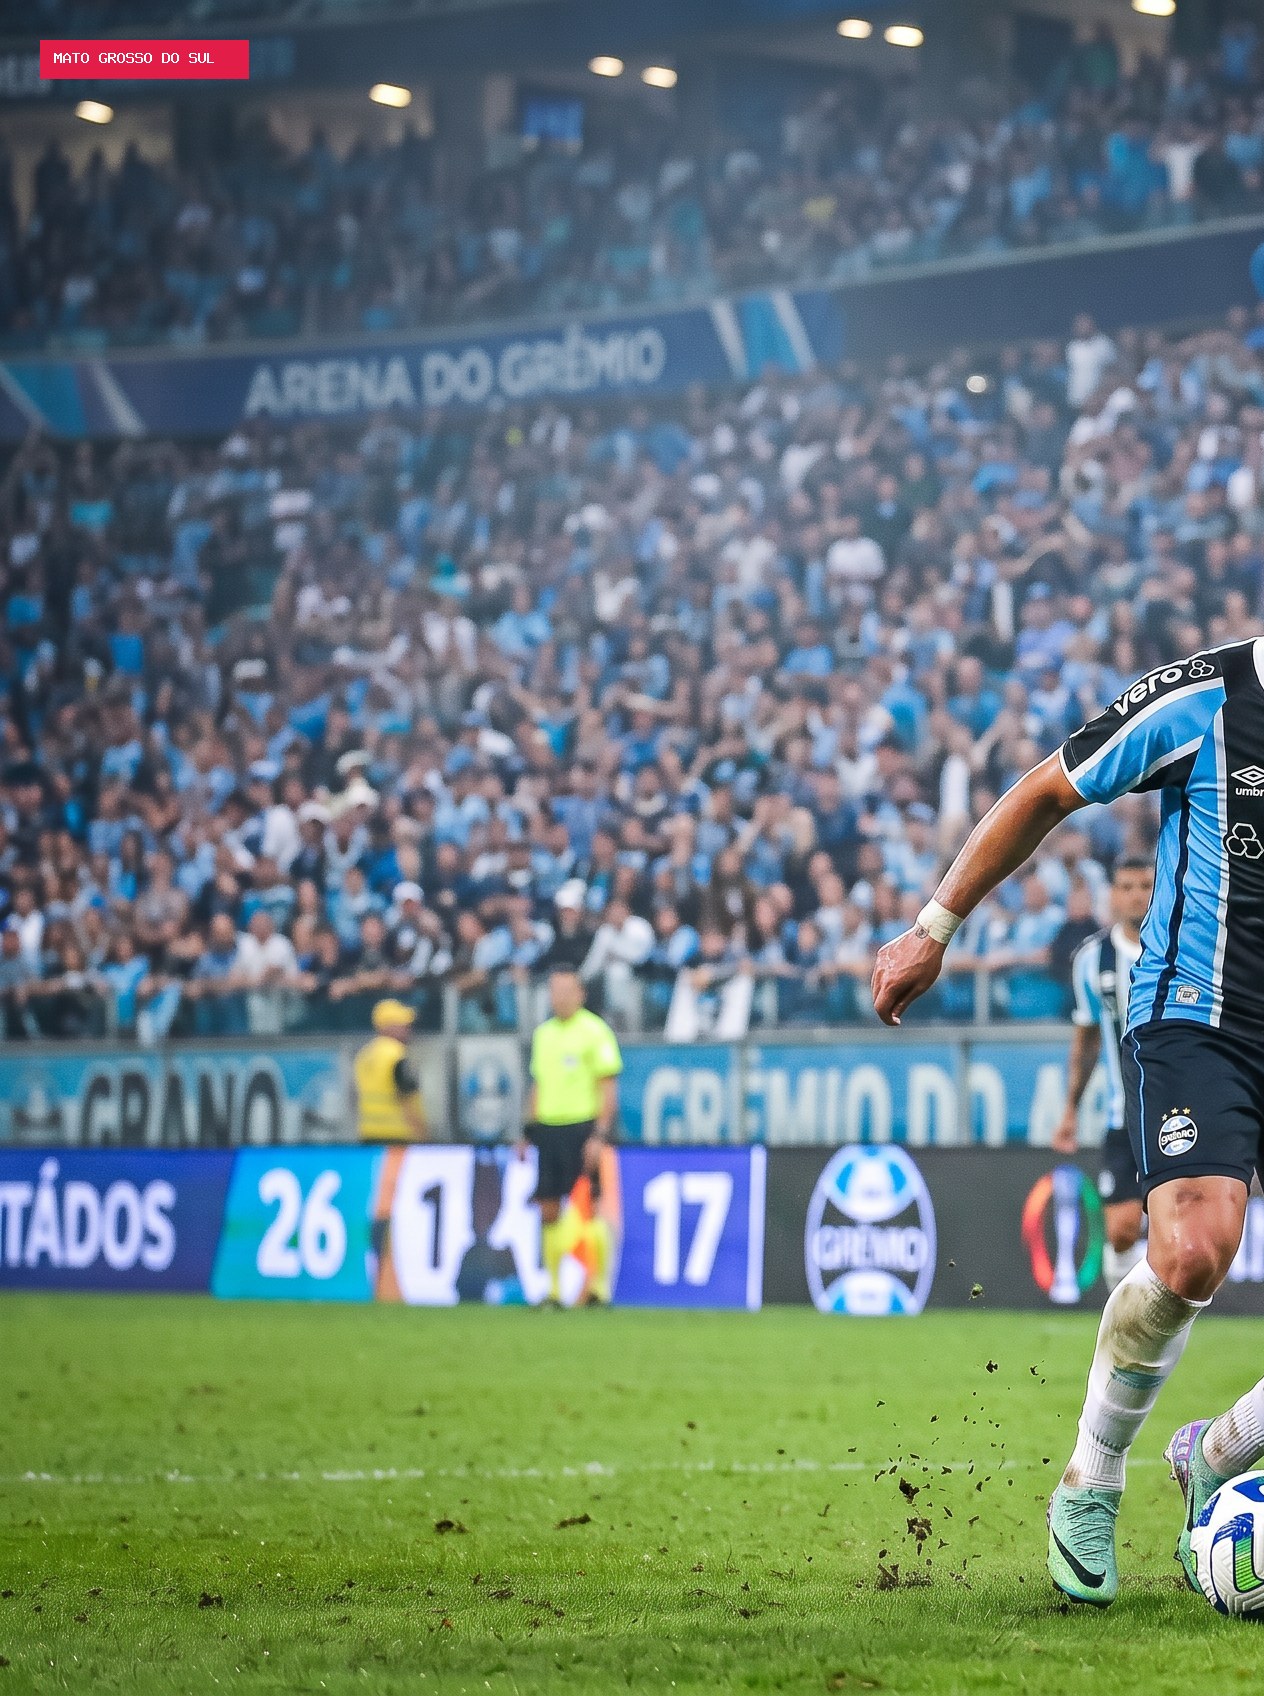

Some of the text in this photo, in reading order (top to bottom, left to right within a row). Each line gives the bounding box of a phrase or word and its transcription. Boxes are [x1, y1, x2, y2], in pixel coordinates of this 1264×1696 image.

[244, 355, 416, 419] ARENA
[420, 346, 493, 404] DO
[1113, 667, 1183, 716] vero
[256, 1167, 348, 1279] 26
[643, 1172, 734, 1285] 17
